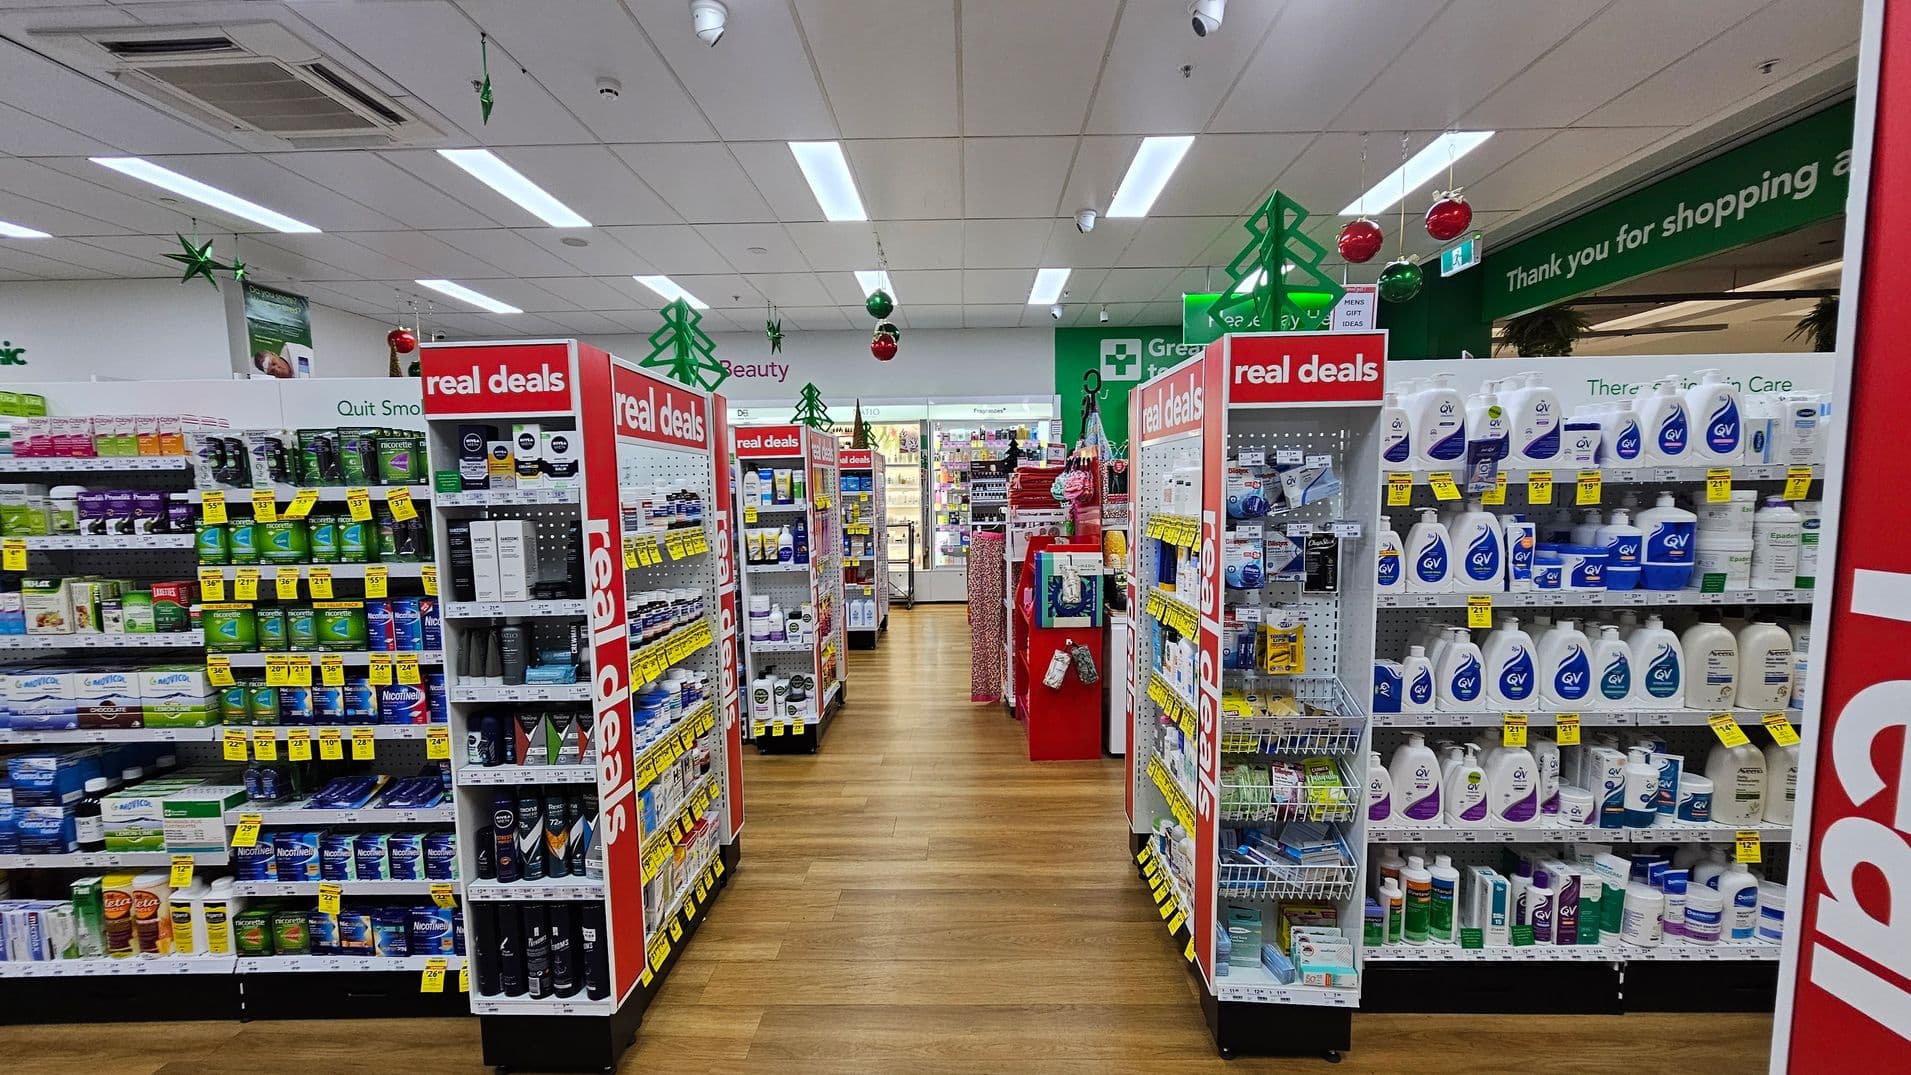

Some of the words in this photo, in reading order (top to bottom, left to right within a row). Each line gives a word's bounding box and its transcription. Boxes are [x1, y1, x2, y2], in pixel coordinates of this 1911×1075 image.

[1507, 252, 1562, 293] Thank
[1567, 240, 1609, 279] you
[1617, 222, 1654, 255] for
[1663, 160, 1818, 237] shopping
[1148, 338, 1204, 357] Grea
[720, 360, 789, 383] Beauty
[1235, 355, 1290, 384] real
[1298, 353, 1379, 383] deals
[427, 366, 481, 395] real
[488, 363, 565, 394] deals
[1749, 376, 1792, 392] Care
[337, 400, 376, 417] Quit
[1142, 387, 1163, 434] real
[1165, 373, 1202, 429] deals
[1439, 403, 1455, 414] QV
[1536, 402, 1551, 413] QV
[616, 387, 656, 434] real
[660, 393, 705, 442] deals
[1391, 420, 1403, 429] QV
[1489, 419, 1502, 428] QV
[1665, 428, 1683, 441] QV
[1714, 423, 1735, 436] QV
[737, 435, 762, 449] real
[764, 434, 799, 448] deals
[1576, 439, 1592, 449] QV
[1621, 439, 1636, 449] QV
[850, 456, 871, 464] deals
[266, 521, 294, 529] nicorette
[1663, 534, 1690, 549] QV
[716, 511, 736, 597] real
[1619, 544, 1637, 555] QV
[1472, 552, 1493, 565] QV
[1515, 552, 1529, 562] QV
[1379, 563, 1395, 574] QV
[1423, 557, 1442, 569] QV
[1200, 511, 1220, 632] real
[1584, 565, 1601, 575] QV
[1547, 572, 1559, 580] QV
[584, 519, 626, 646] real
[721, 608, 738, 730] deals
[1654, 669, 1673, 680] QV
[93, 675, 128, 686] MOVICOL
[157, 674, 190, 686] MOVICOL
[1458, 677, 1475, 688] QV
[1507, 672, 1527, 685] QV
[1561, 672, 1583, 685] QV
[1608, 674, 1625, 685] QV
[1379, 682, 1390, 697] QV
[1415, 684, 1428, 693] QV
[1198, 649, 1219, 823] deals
[597, 664, 633, 845] deals
[1416, 768, 1431, 778] QV
[1513, 769, 1528, 779] QV
[1608, 767, 1621, 777] QV
[1370, 782, 1383, 791] QV
[1467, 783, 1480, 791] QV
[1659, 779, 1673, 789] QV
[1693, 801, 1708, 809] QV
[1571, 807, 1582, 815] QV
[1535, 910, 1551, 919] QV
[1560, 905, 1578, 916] QV
[235, 919, 266, 927] nicorette
[275, 917, 306, 925] nicorette
